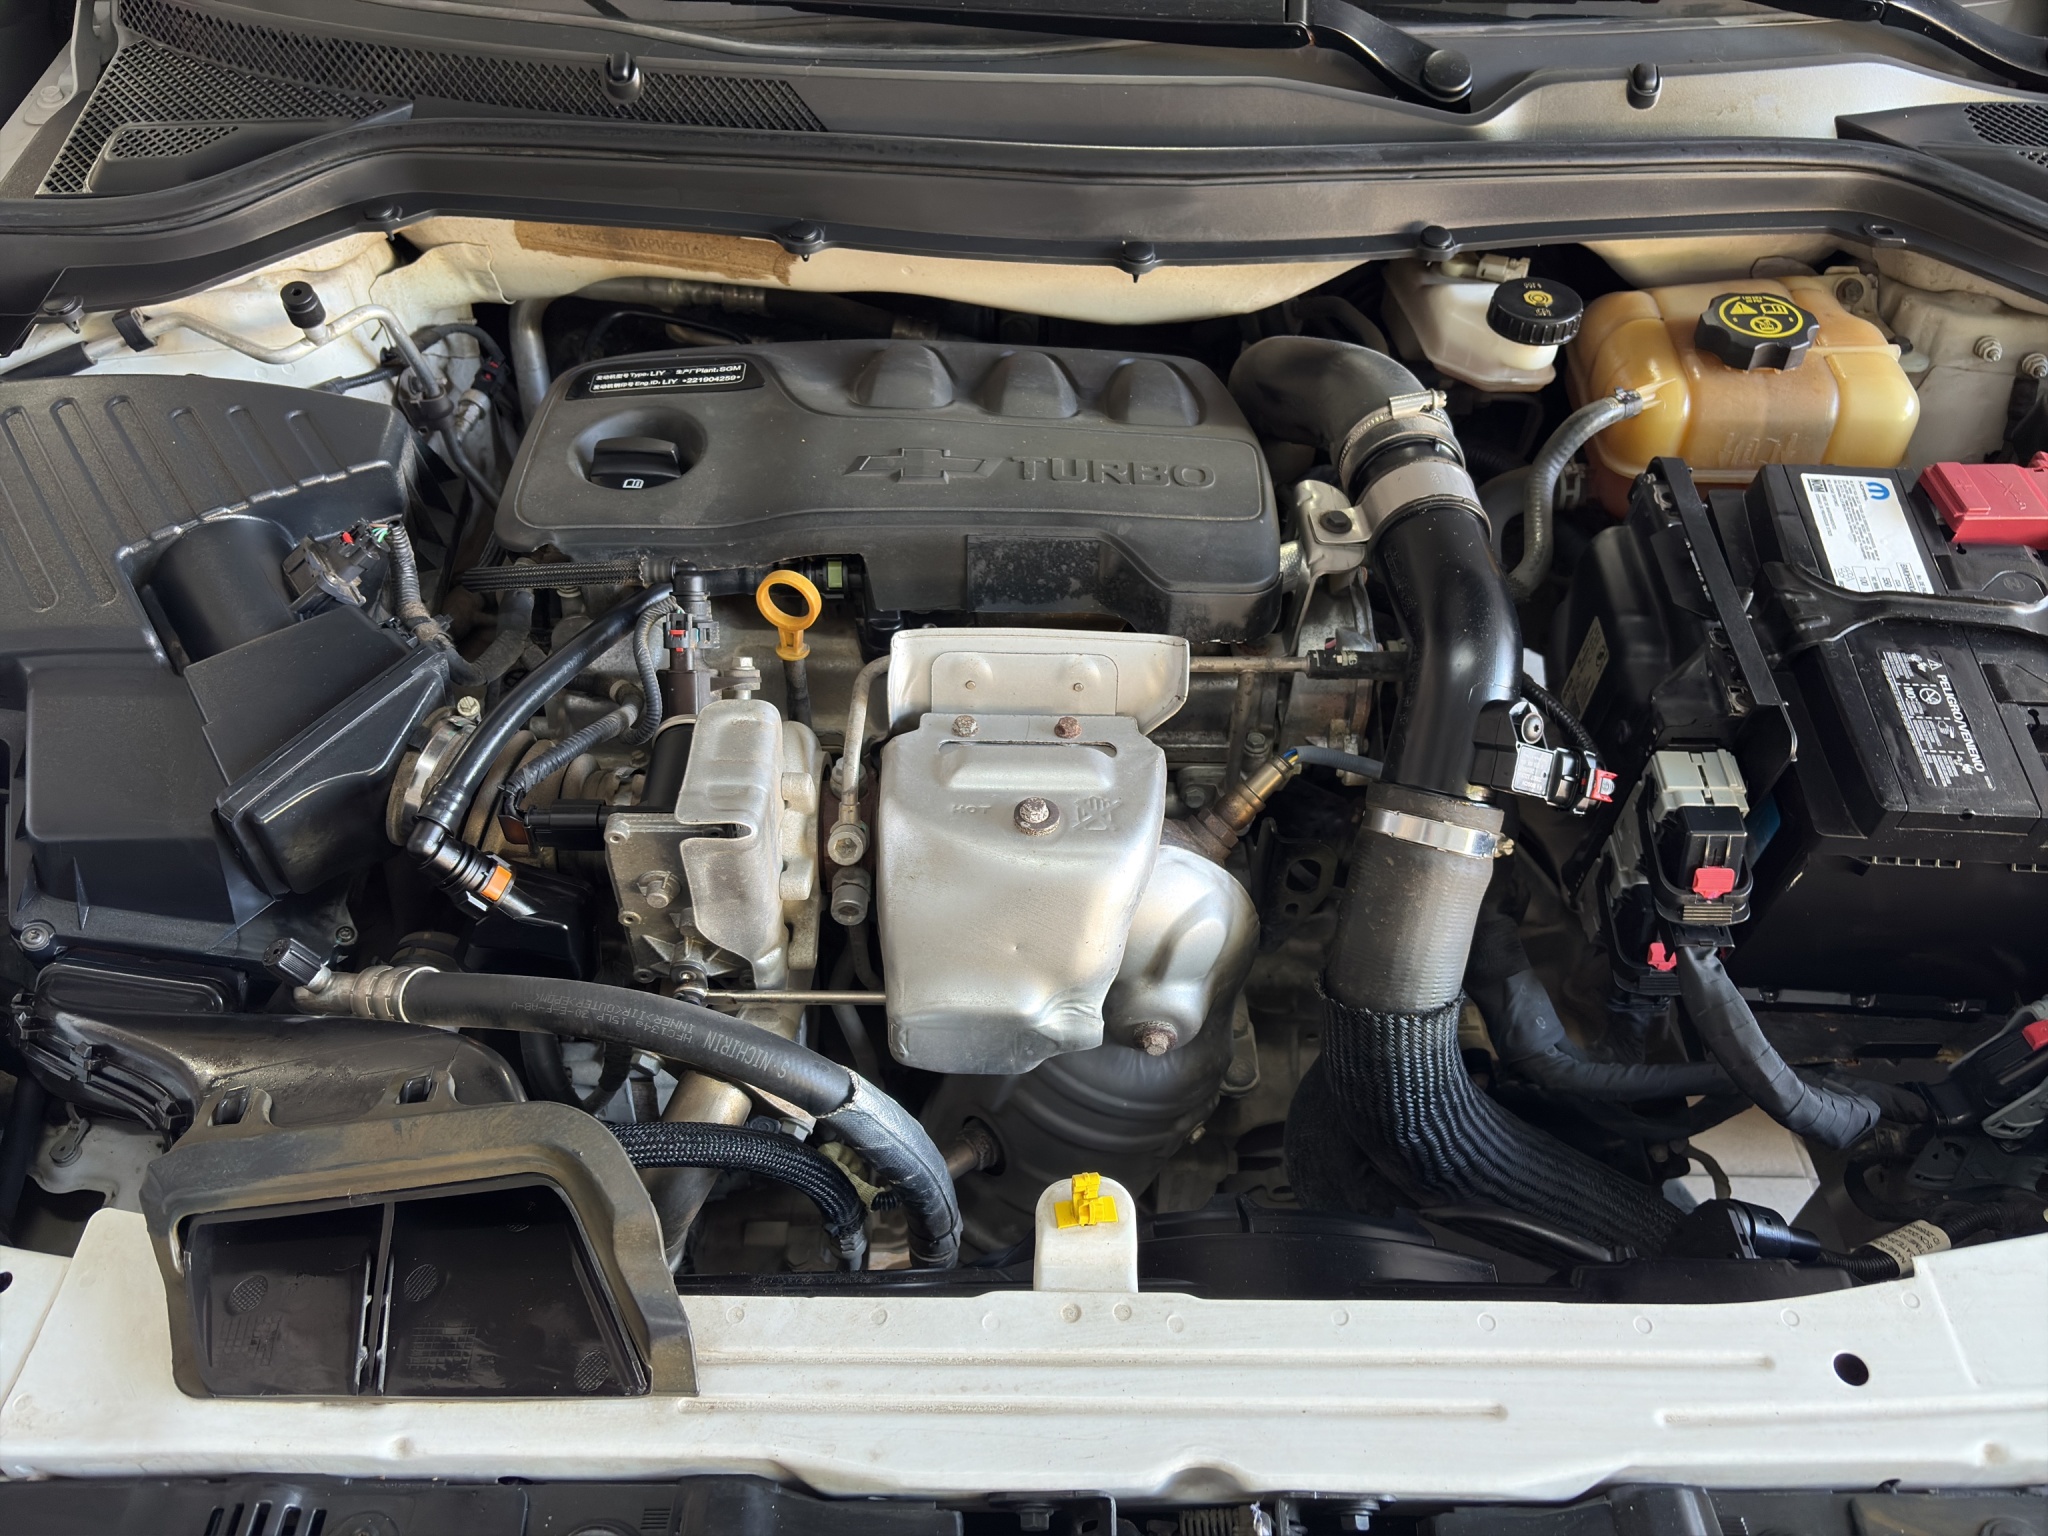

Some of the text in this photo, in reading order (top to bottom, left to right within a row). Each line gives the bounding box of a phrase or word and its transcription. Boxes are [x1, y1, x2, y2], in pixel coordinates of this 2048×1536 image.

[1011, 455, 1216, 488] TURBO
[1937, 674, 1985, 773] PELIGRO/VENENO
[951, 804, 992, 815] HOT
